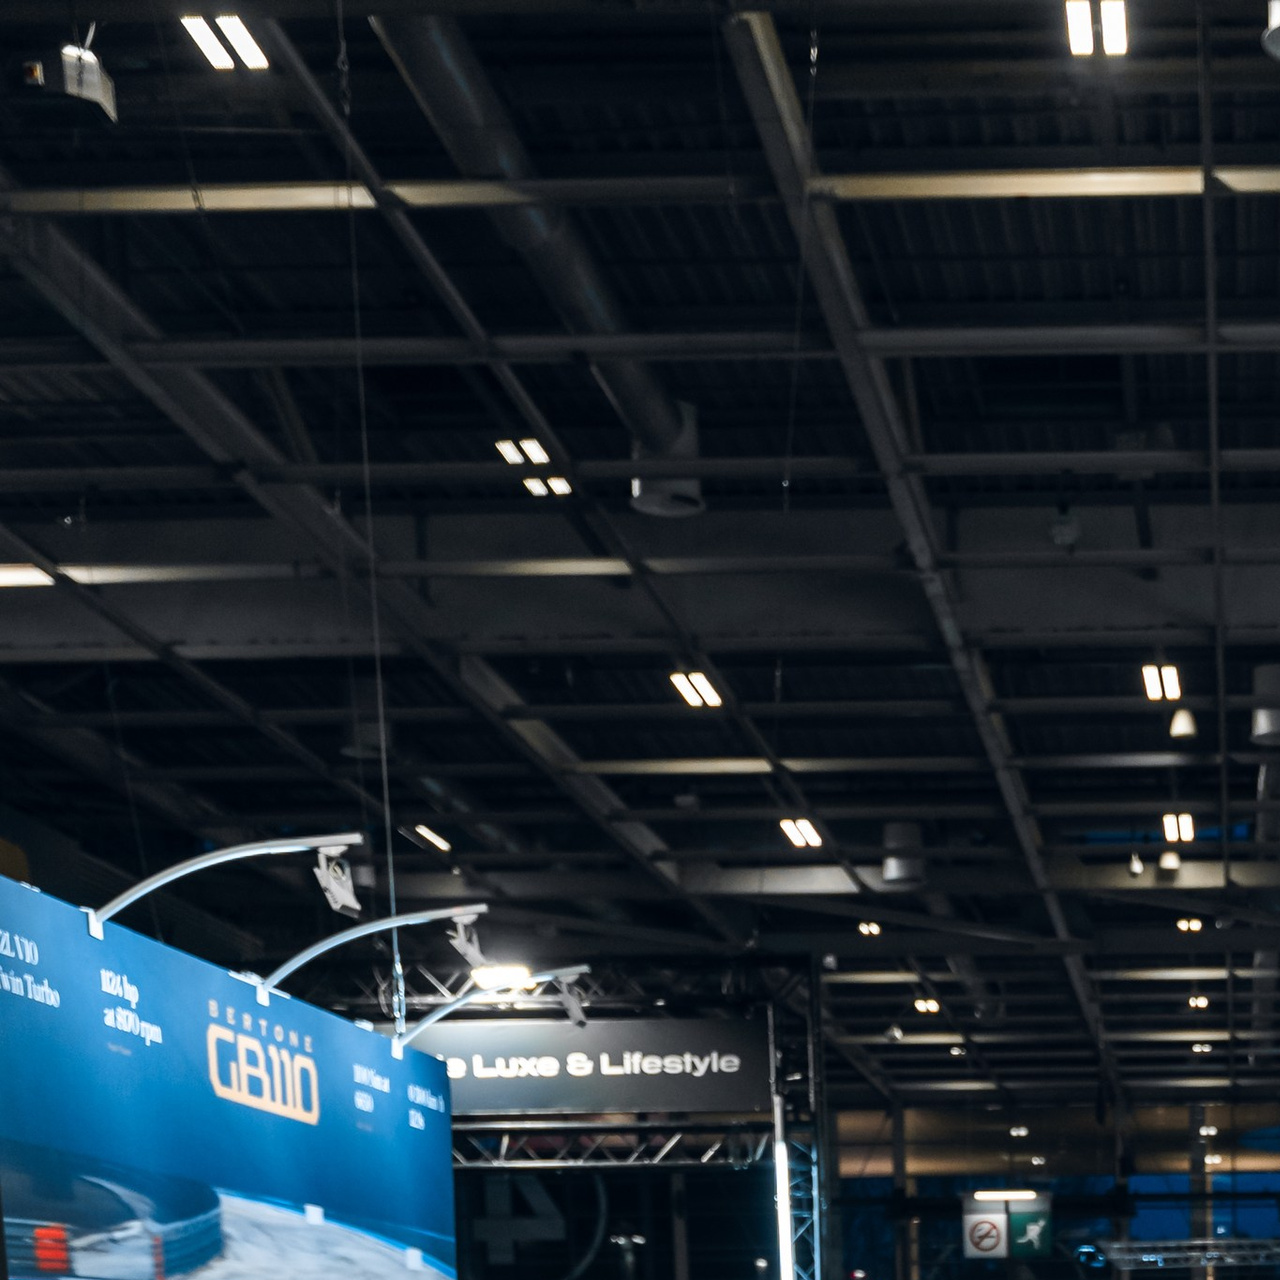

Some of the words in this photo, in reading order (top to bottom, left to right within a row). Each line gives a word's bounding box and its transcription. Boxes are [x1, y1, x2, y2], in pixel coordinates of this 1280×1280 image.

[23, 973, 61, 1008] Turbo
[208, 998, 313, 1053] BERTONE
[207, 1022, 320, 1127] GB110
[472, 1053, 560, 1078] Luxe
[566, 1052, 594, 1077] &
[600, 1051, 741, 1077] Lifestyle
